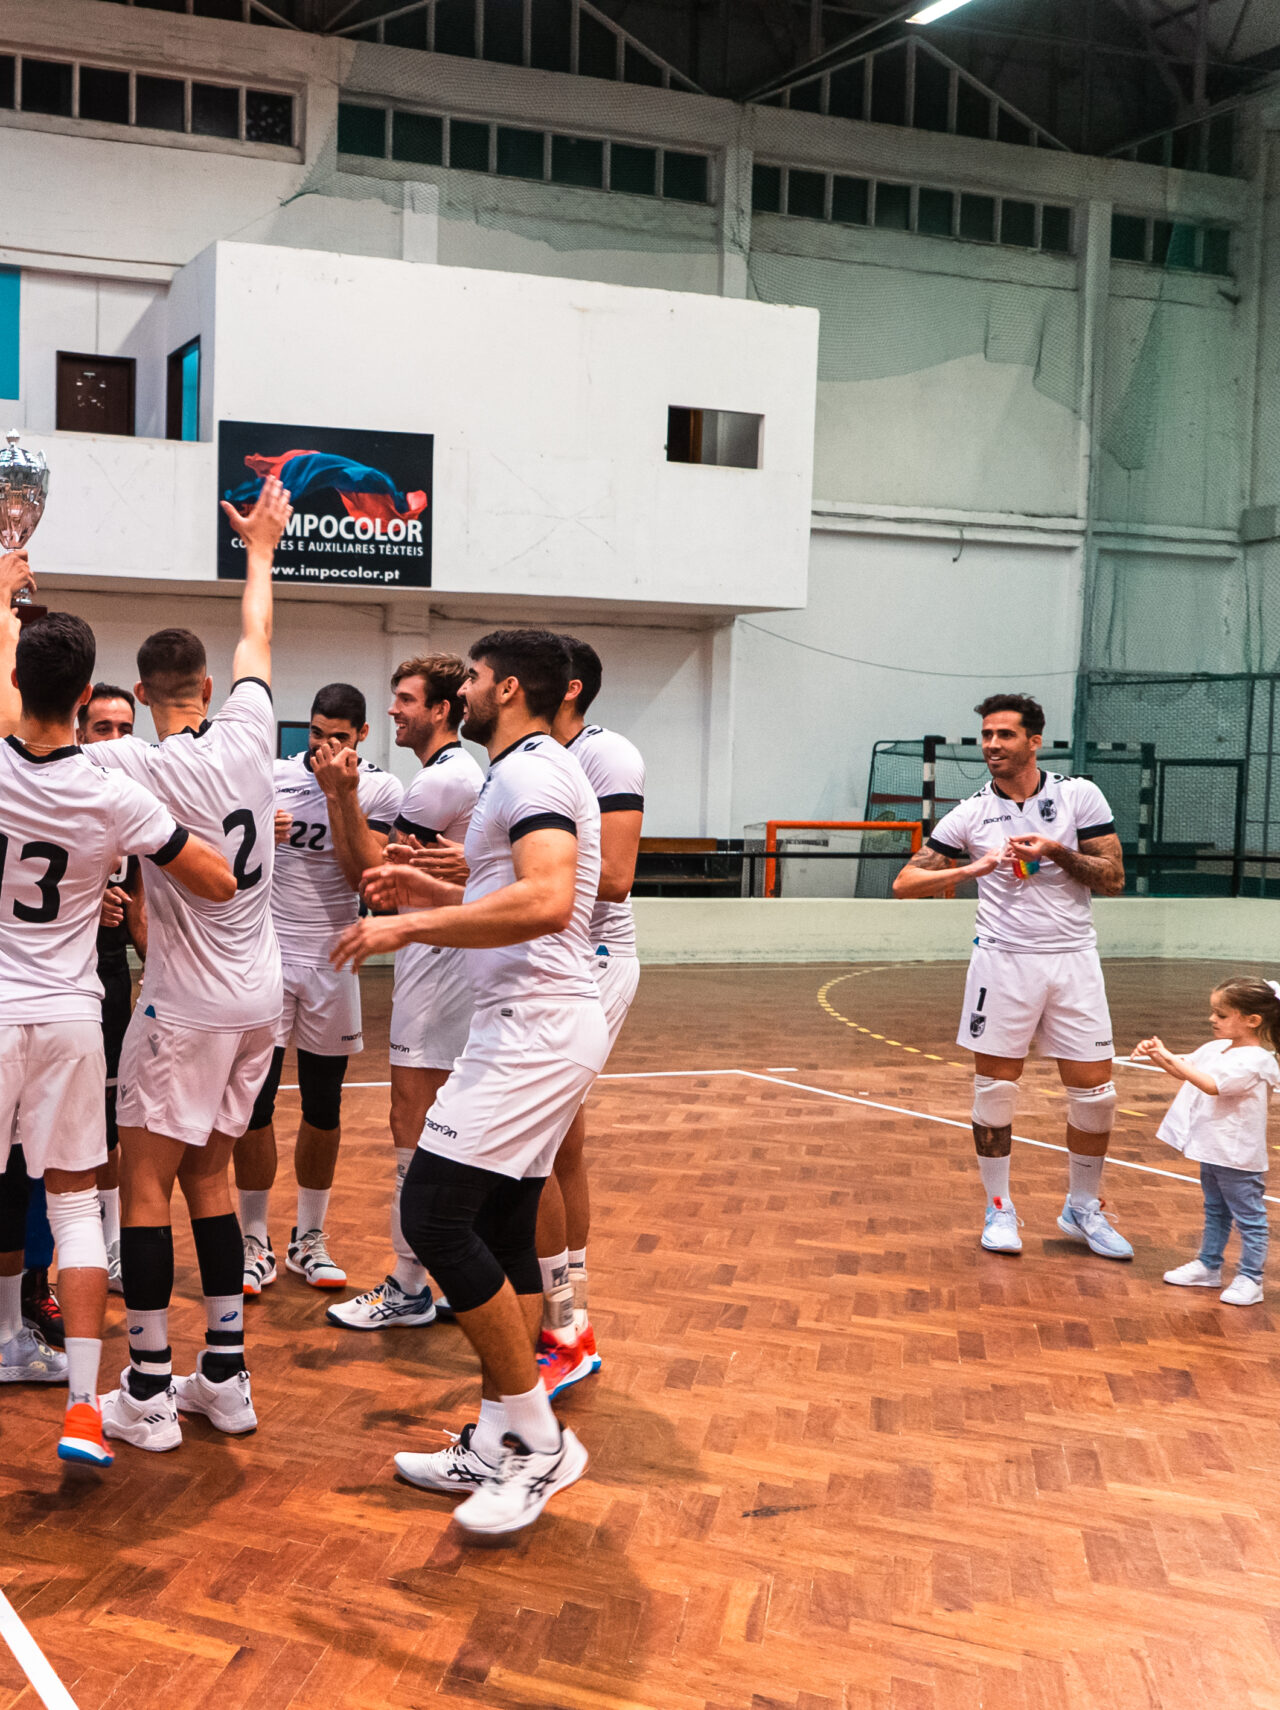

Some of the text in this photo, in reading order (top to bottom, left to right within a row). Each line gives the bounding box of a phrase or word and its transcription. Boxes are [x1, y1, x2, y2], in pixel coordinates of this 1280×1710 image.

[297, 540, 305, 551] E
[308, 541, 376, 555] AUXILIARES
[378, 543, 424, 557] TÊXTEIS
[290, 821, 327, 851] 22
[222, 809, 262, 891] 2
[976, 987, 987, 1012] 1
